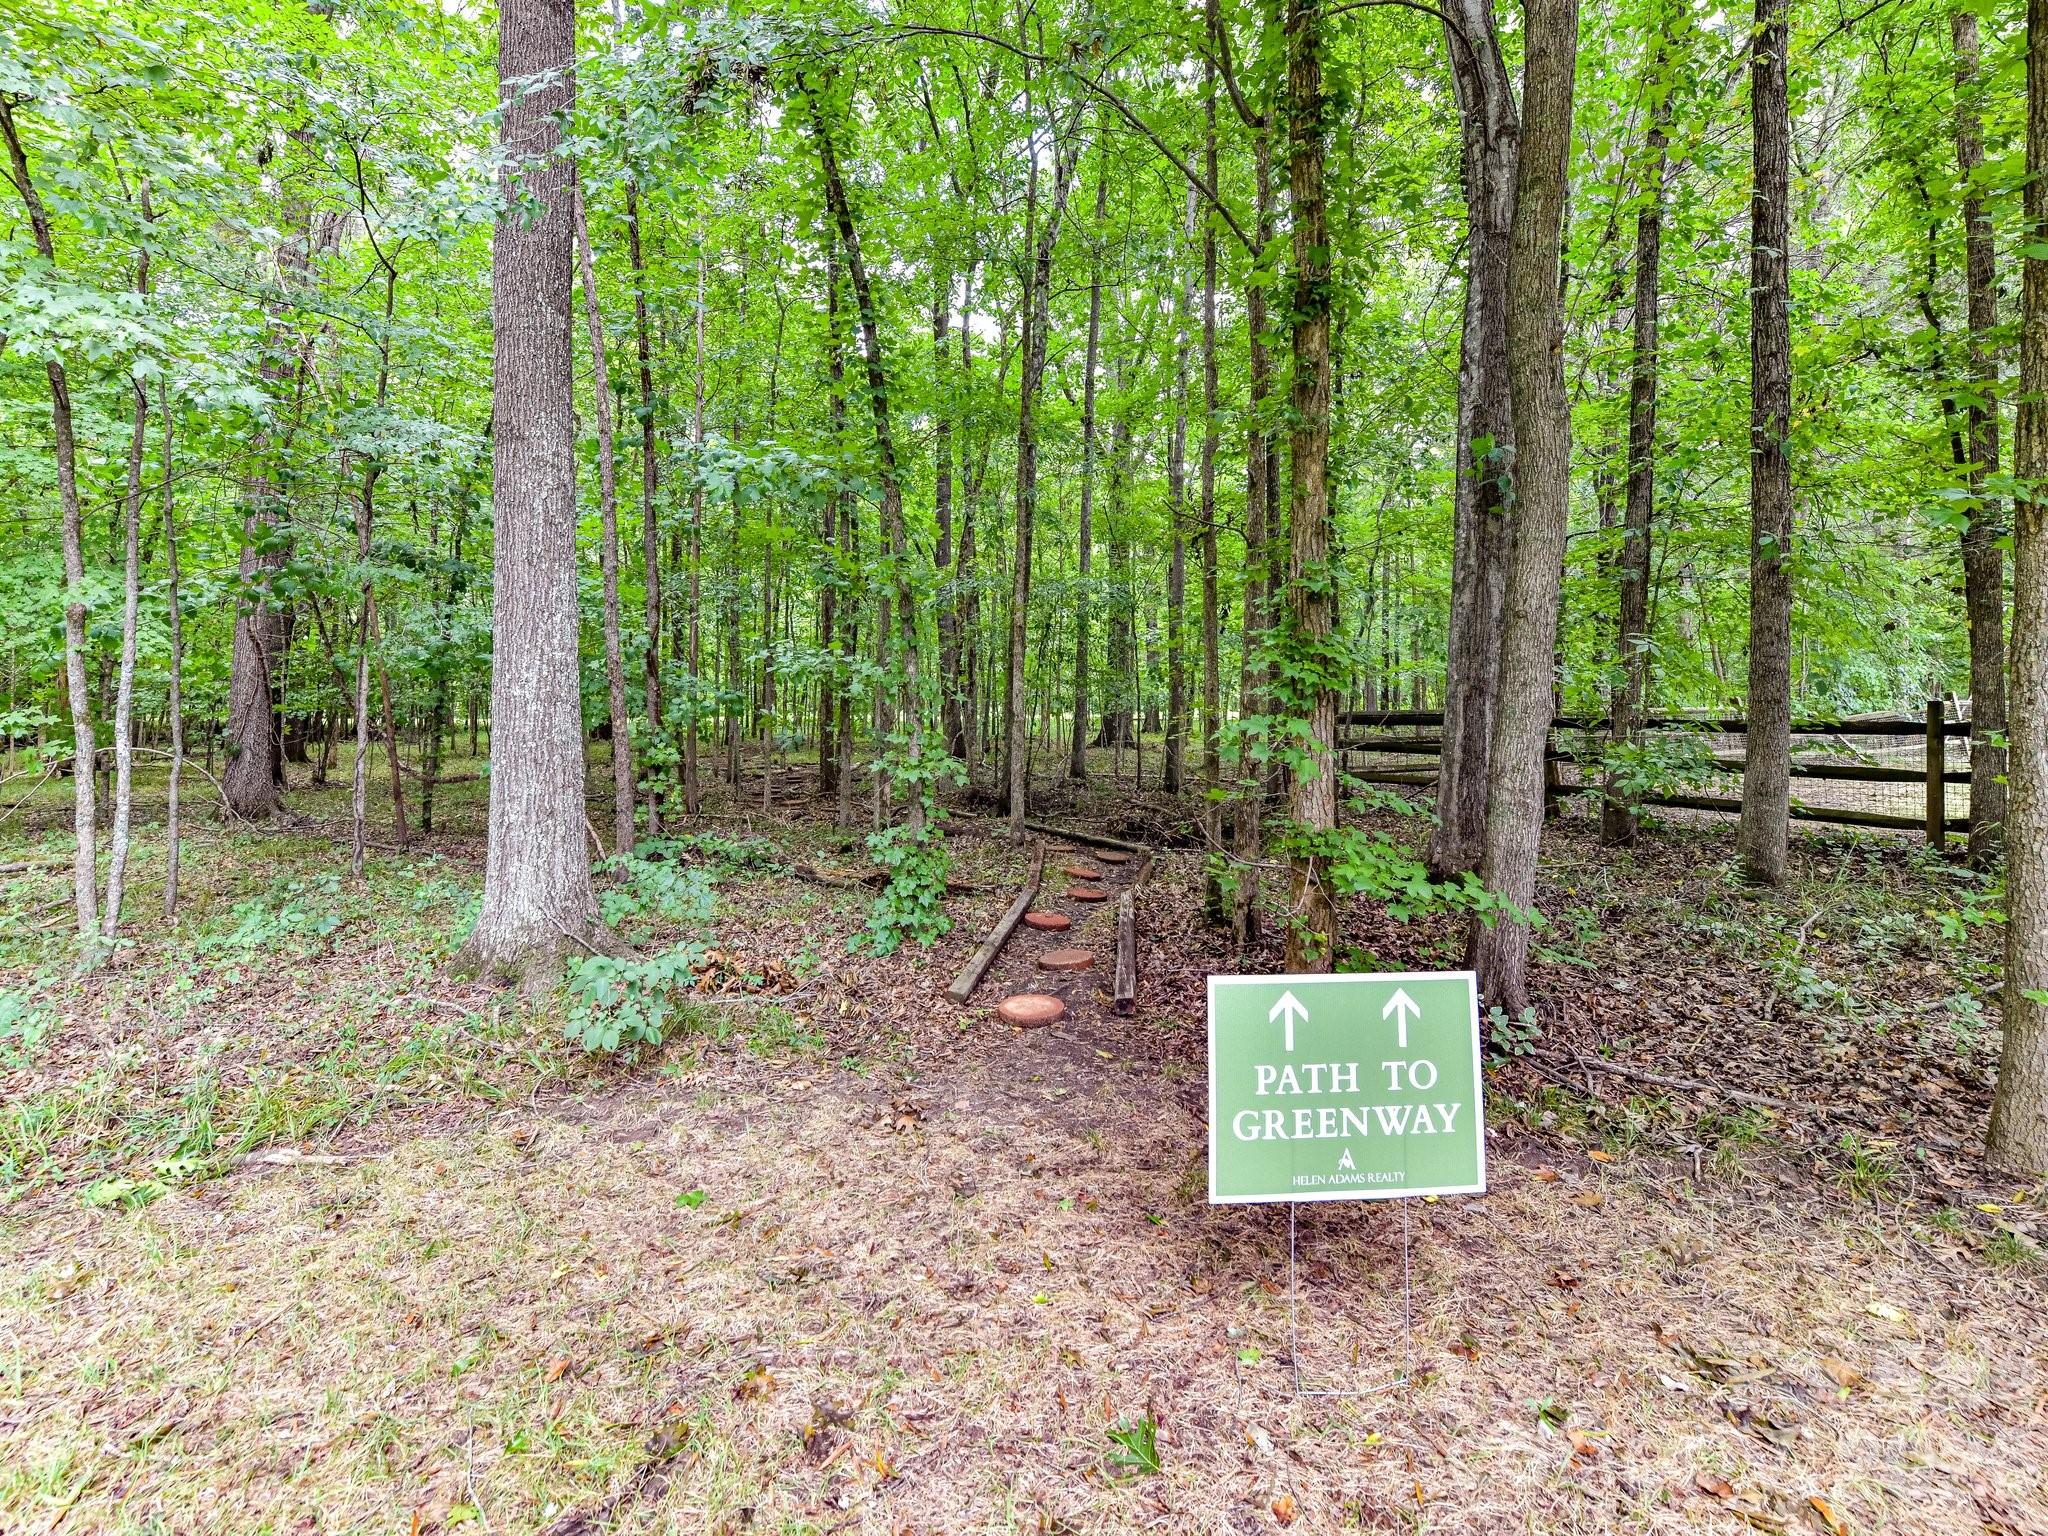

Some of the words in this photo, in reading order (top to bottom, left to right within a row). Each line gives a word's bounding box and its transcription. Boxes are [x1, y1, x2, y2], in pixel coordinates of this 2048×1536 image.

[1254, 1063, 1360, 1096] PATH
[1382, 1059, 1438, 1091] TO
[1232, 1103, 1461, 1141] GREENWAY
[1292, 1174, 1326, 1186] HELEN
[1328, 1173, 1365, 1185] ADAMS
[1367, 1171, 1406, 1184] REALTY
